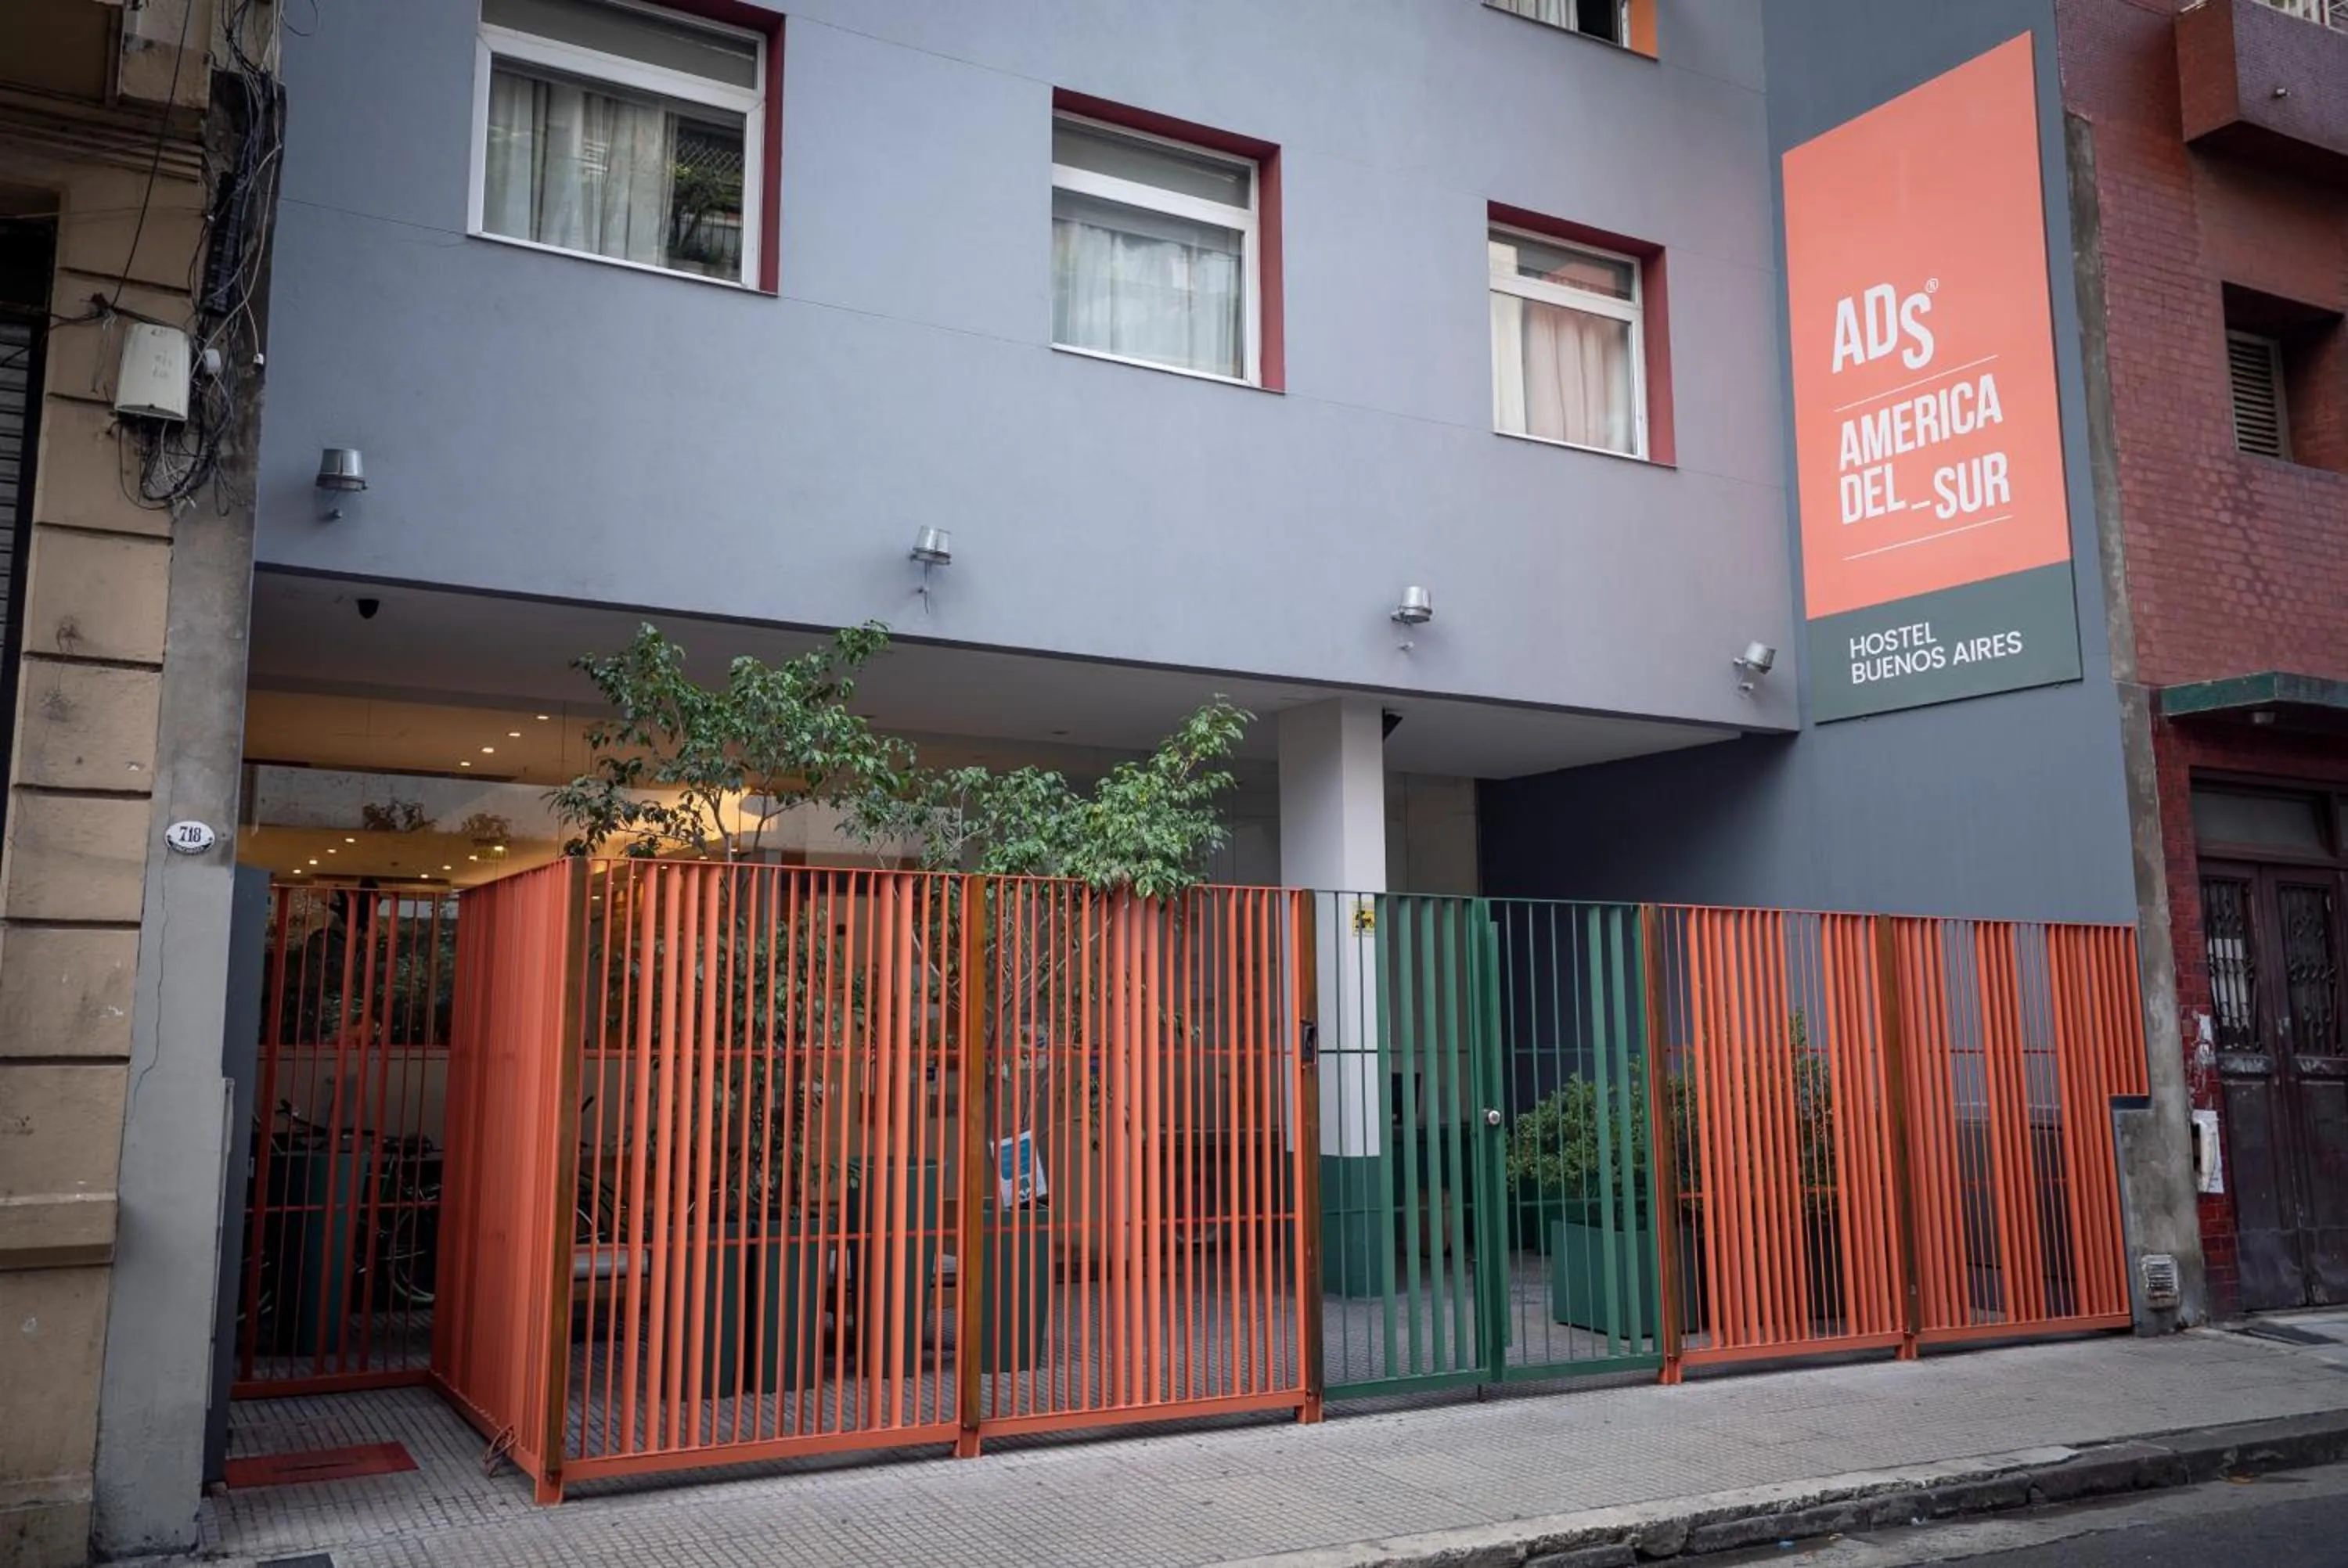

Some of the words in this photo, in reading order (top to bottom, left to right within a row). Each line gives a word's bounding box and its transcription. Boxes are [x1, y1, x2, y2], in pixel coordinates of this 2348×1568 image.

[1840, 374, 2003, 471] AMERICA
[1849, 622, 1937, 659] HOSTEL
[1851, 646, 1946, 684] BUENOS
[1953, 631, 2022, 665] AIRES
[179, 826, 201, 843] 718
